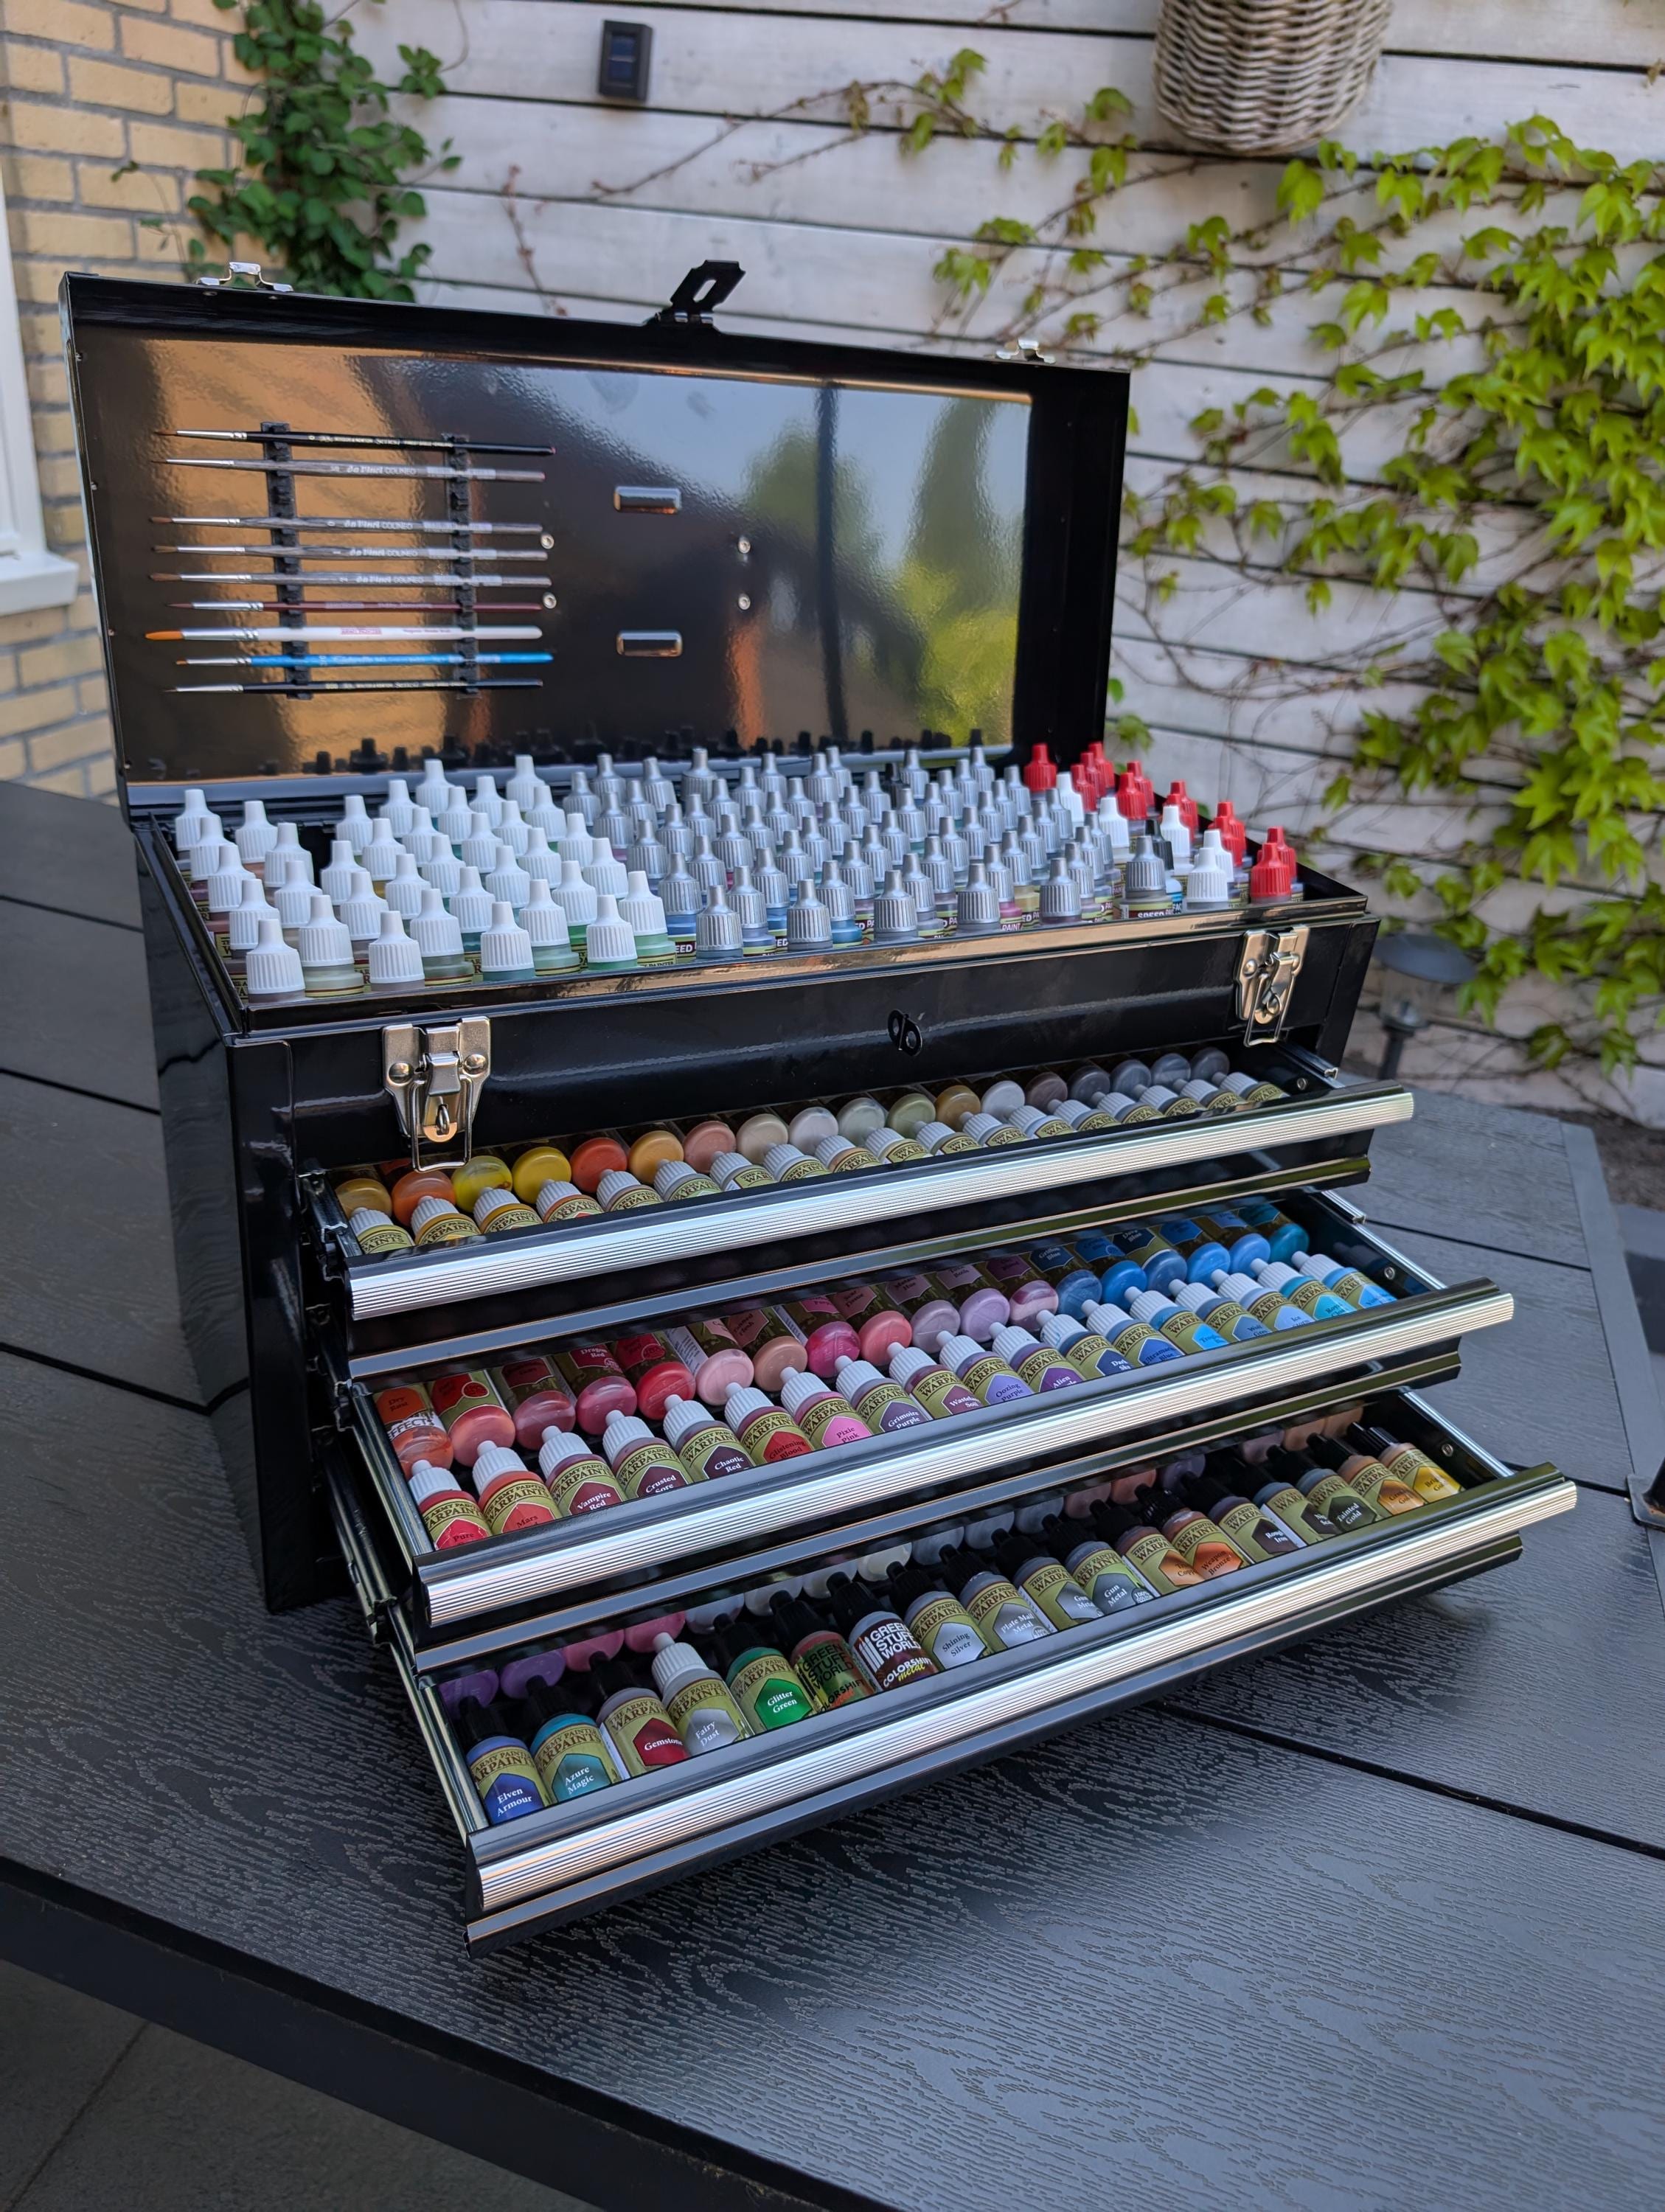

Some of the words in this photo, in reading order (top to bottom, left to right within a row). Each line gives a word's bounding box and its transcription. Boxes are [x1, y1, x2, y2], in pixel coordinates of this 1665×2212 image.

[675, 945, 692, 953] EED
[918, 1383, 931, 1393] THE
[931, 1374, 949, 1383] ARMY
[995, 1382, 1021, 1398] Oozing
[1052, 1375, 1071, 1388] Alien
[868, 1391, 885, 1403] ARMY
[811, 1405, 830, 1418] ARMY
[753, 1419, 772, 1431] ARMY
[896, 1416, 921, 1429] Purple
[836, 1427, 855, 1439] Pixie
[841, 1433, 860, 1444] Pink
[683, 1445, 694, 1458] THE
[694, 1433, 715, 1447] ARMY
[769, 1440, 806, 1460] Glistening
[779, 1447, 803, 1459] Blood
[628, 1452, 646, 1467] ARMY
[714, 1455, 744, 1471] Chaotic
[561, 1467, 581, 1482] ARMY
[726, 1463, 741, 1474] Red
[645, 1475, 677, 1493] Crusted
[495, 1489, 515, 1505] ARMY
[577, 1492, 612, 1510] Vampire
[431, 1504, 453, 1516] ARMY
[589, 1501, 606, 1511] Red
[1337, 1503, 1360, 1522] Tainted
[517, 1515, 538, 1528] Mars
[1226, 1517, 1237, 1526] THE
[1238, 1506, 1254, 1516] ARMY
[1345, 1510, 1363, 1525] Gold
[453, 1532, 474, 1542] Pure
[1133, 1548, 1144, 1557] THE
[1145, 1539, 1162, 1548] ARMY
[1202, 1551, 1227, 1571] Weapon
[1208, 1557, 1231, 1576] Bronze
[1031, 1576, 1042, 1587] THE
[1043, 1570, 1060, 1578] ARMY
[980, 1590, 997, 1603] ARMY
[1104, 1584, 1119, 1599] Gun
[1107, 1588, 1127, 1607] Metal
[922, 1609, 936, 1622] ARMY
[1018, 1613, 1034, 1621] Mail
[870, 1622, 909, 1642] GREEN
[1001, 1618, 1019, 1633] Plate
[1012, 1621, 1033, 1634] Metal
[875, 1632, 915, 1652] STUFF
[881, 1641, 922, 1659] WORLD
[942, 1632, 970, 1652] Shining
[950, 1641, 972, 1657] Silver
[802, 1644, 844, 1673] GREEN
[743, 1663, 763, 1678] ARMY
[808, 1652, 851, 1683] STUFF
[883, 1657, 933, 1688] COLORSHIFT
[898, 1663, 926, 1682] metal
[813, 1663, 854, 1690] WORLD
[671, 1694, 690, 1711] ARMY
[767, 1691, 793, 1707] Glitter
[820, 1679, 865, 1712] OLORSHIFT
[609, 1709, 628, 1725] THE
[628, 1701, 648, 1711] ARMY
[672, 1686, 727, 1724] ARPAINTS
[772, 1699, 799, 1714] Green
[695, 1721, 716, 1740] Fairy
[700, 1729, 720, 1747] Dust
[540, 1733, 601, 1770] ARPAINTS
[543, 1736, 566, 1754] ARMY
[644, 1737, 684, 1751] Gemstone
[476, 1752, 497, 1771] ARMY
[565, 1766, 590, 1786] Azure
[567, 1774, 594, 1795] Magic
[496, 1788, 524, 1804] Elven
[496, 1795, 532, 1817] Armour
